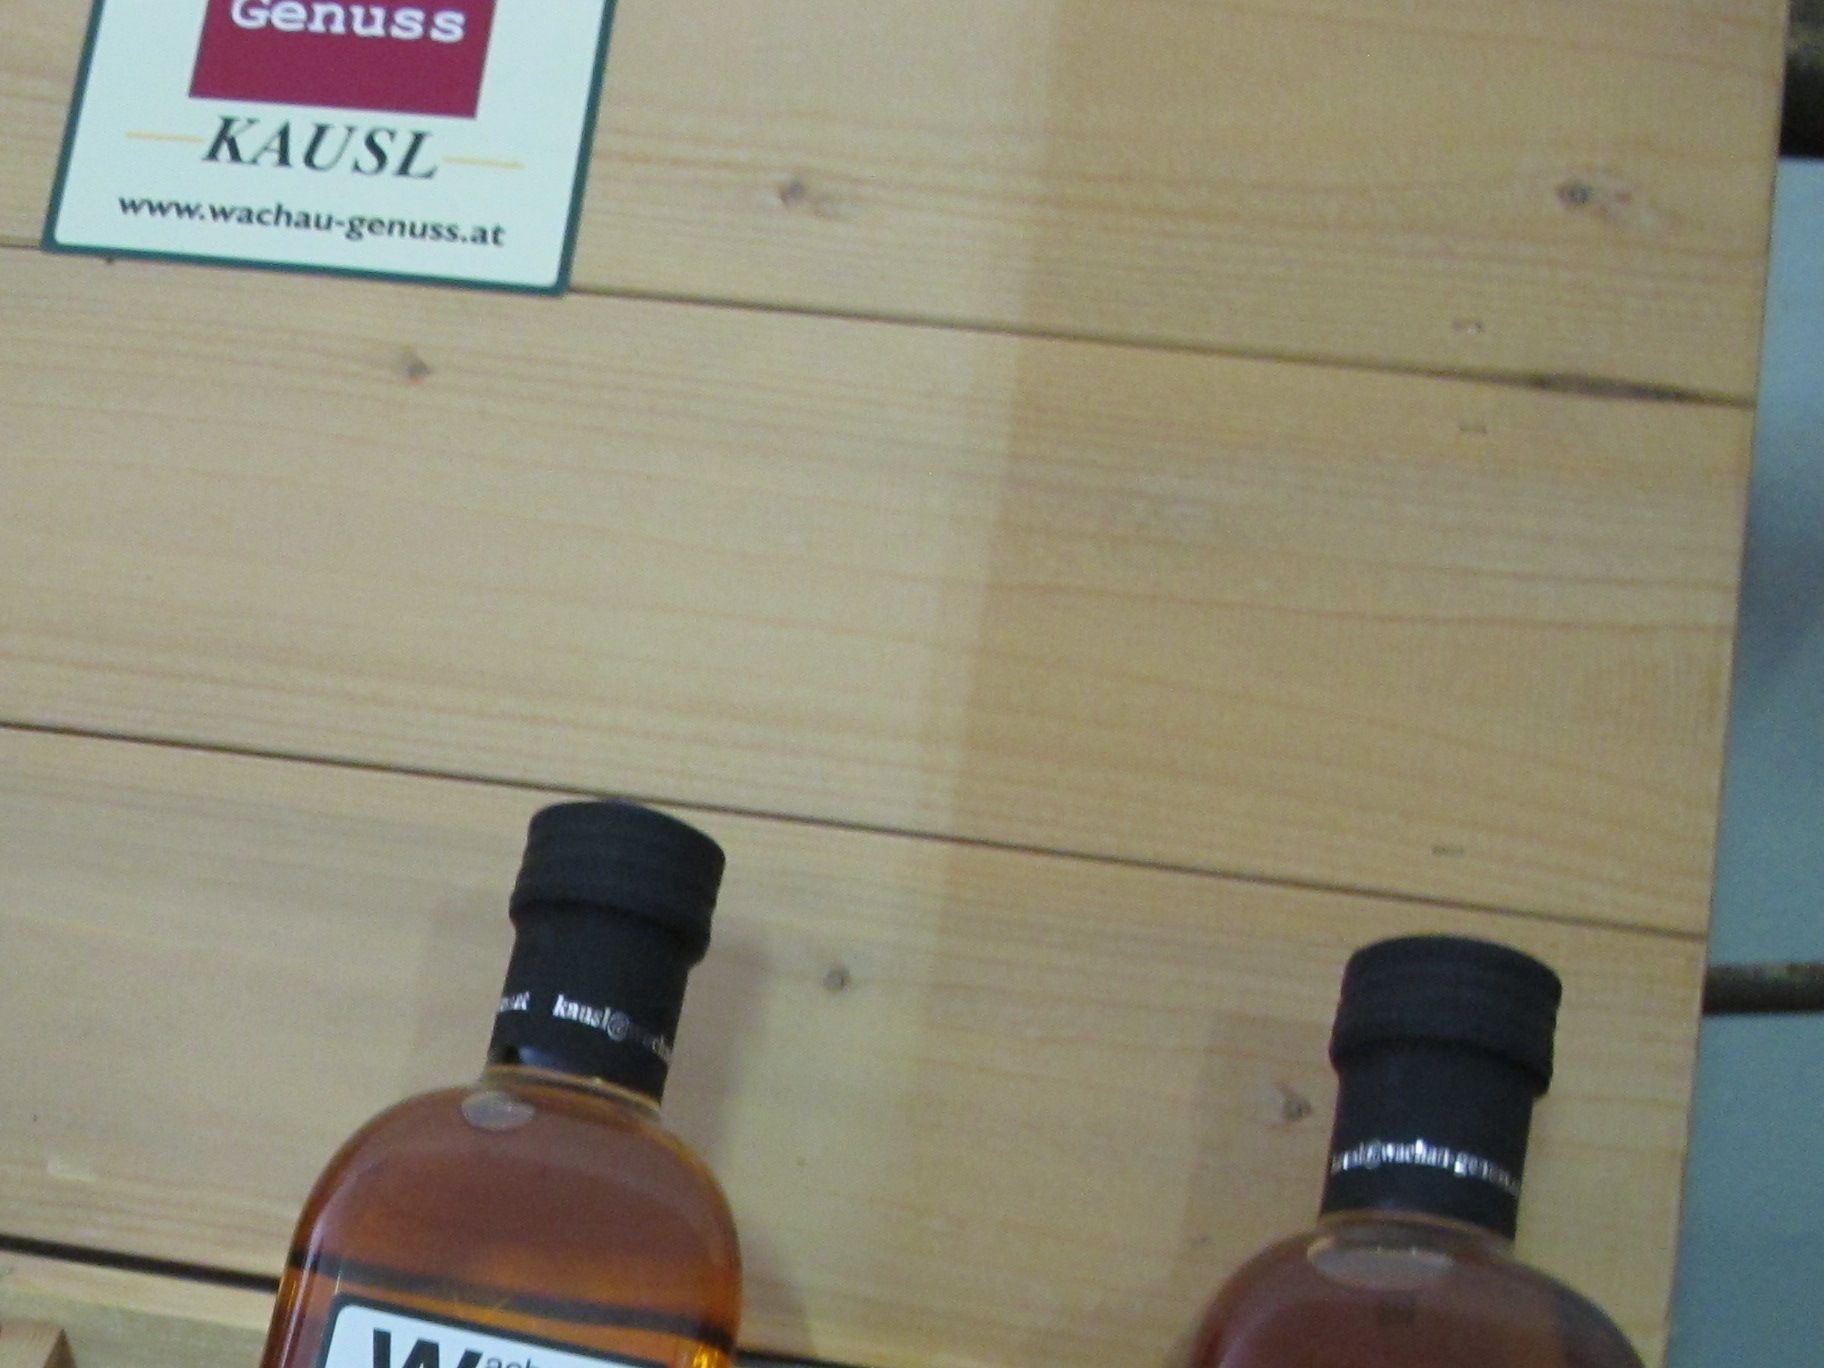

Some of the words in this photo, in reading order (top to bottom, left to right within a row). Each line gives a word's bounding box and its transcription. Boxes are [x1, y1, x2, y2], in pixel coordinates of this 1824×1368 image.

[230, 0, 467, 43] Genuss
[200, 115, 441, 180] KAUSL
[117, 197, 505, 248] www.wachau-genuss.at
